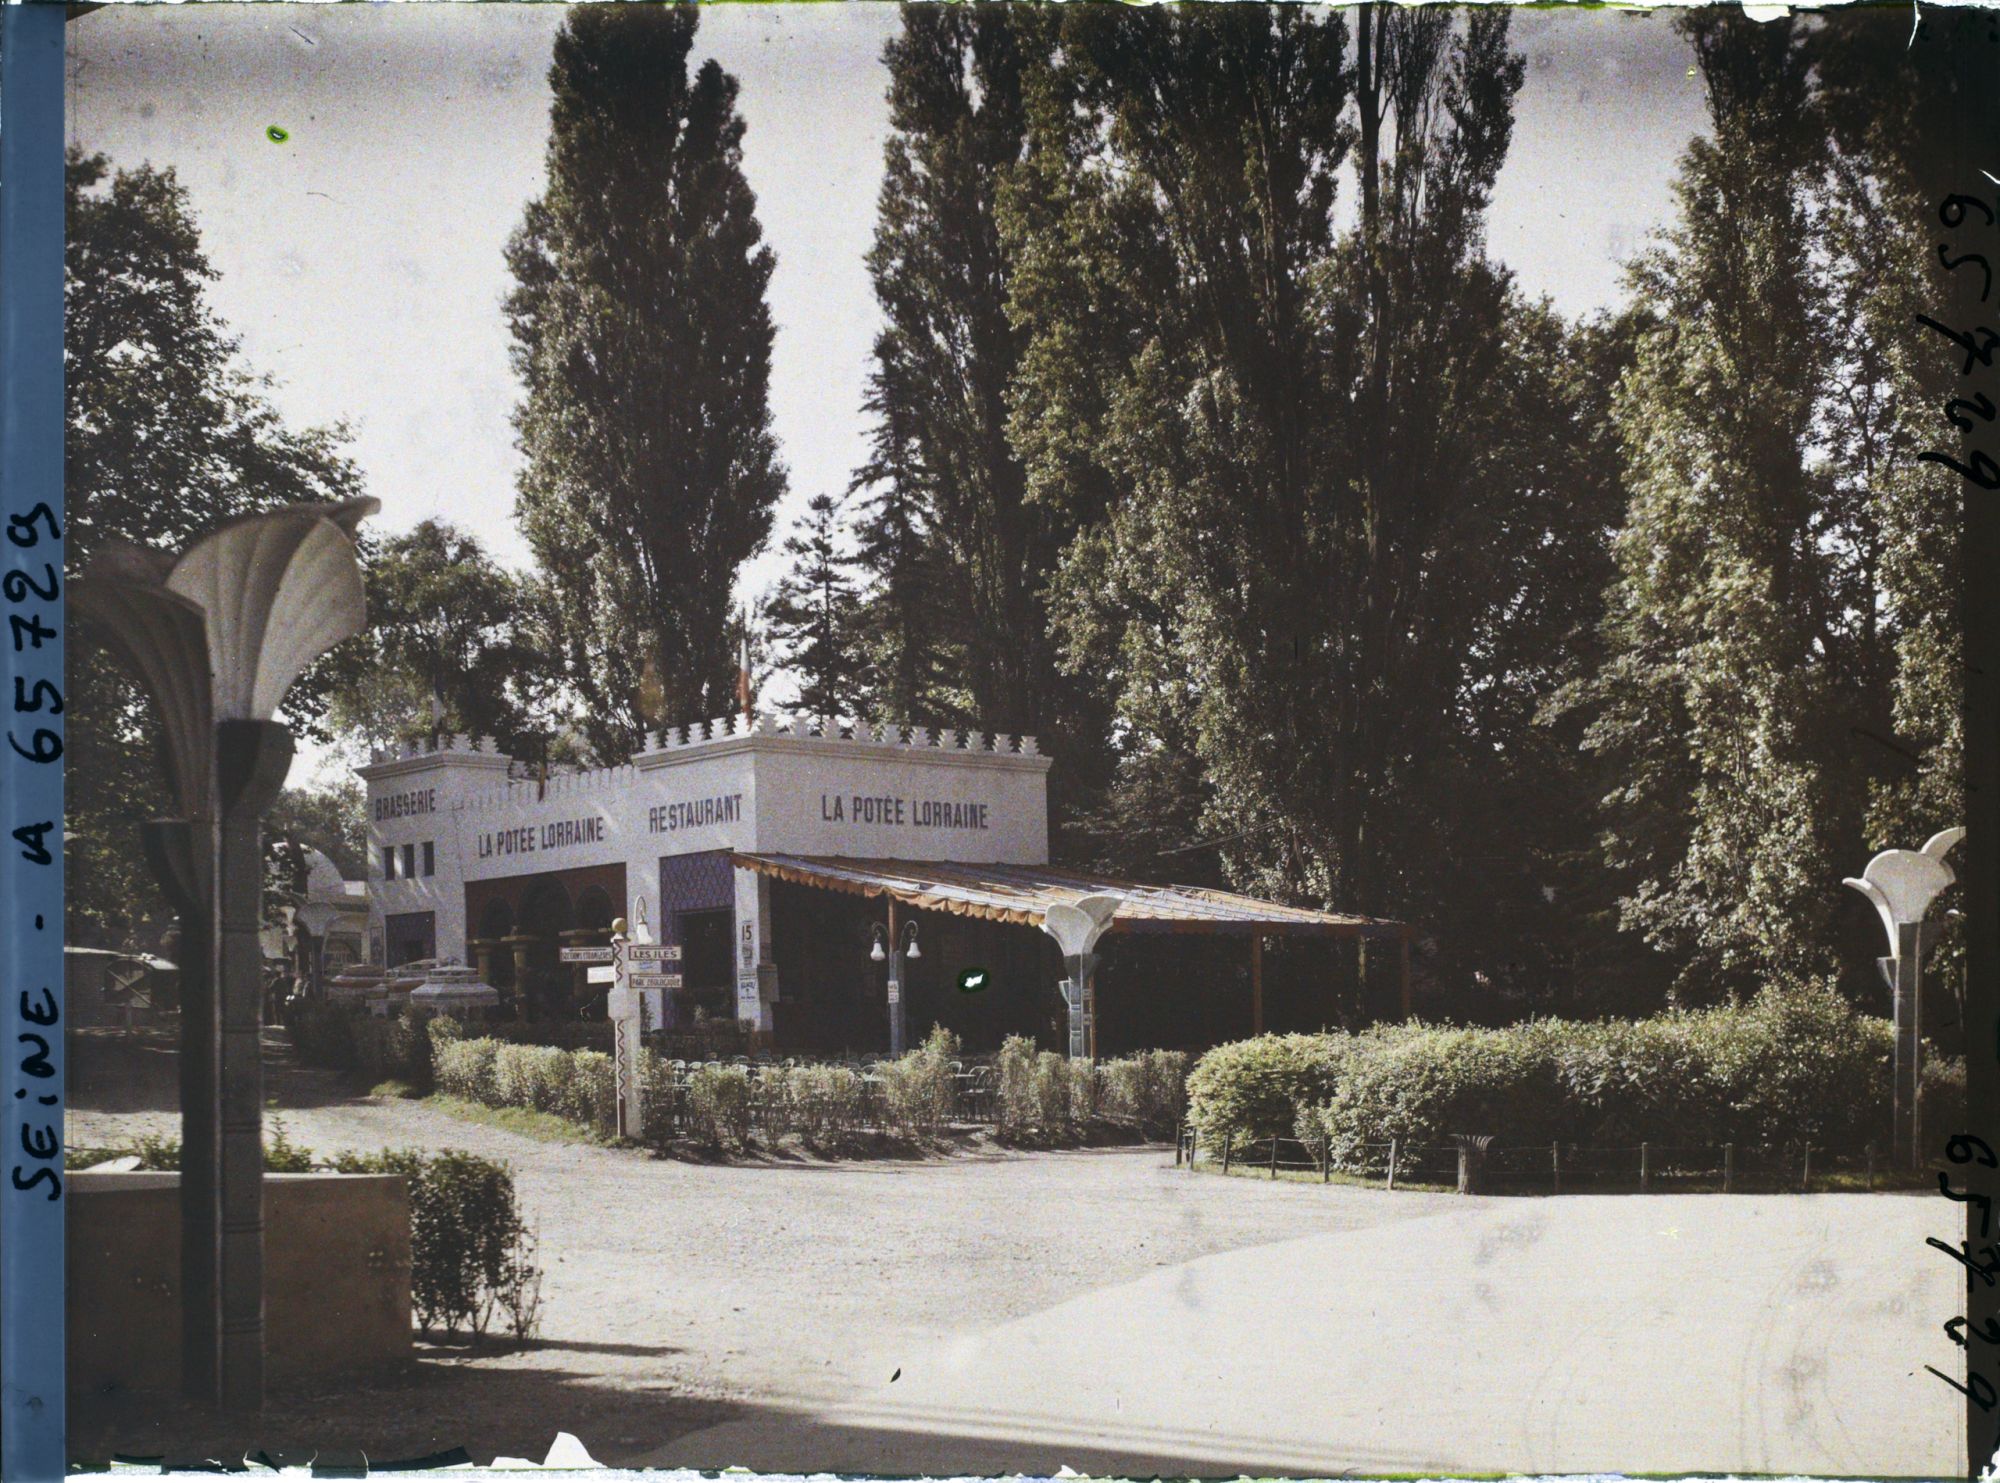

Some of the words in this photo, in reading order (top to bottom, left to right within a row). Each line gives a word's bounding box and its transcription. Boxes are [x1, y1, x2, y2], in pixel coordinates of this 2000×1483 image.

[3, 501, 64, 765] 65729
[375, 788, 437, 821] BRASSERIE
[649, 793, 743, 833] RESTAURANT
[822, 795, 844, 821] LA
[912, 800, 989, 829] LORRAINE
[12, 819, 54, 867] A
[478, 832, 493, 858] LA
[541, 817, 604, 849] LORRAINE
[633, 950, 652, 959] LES
